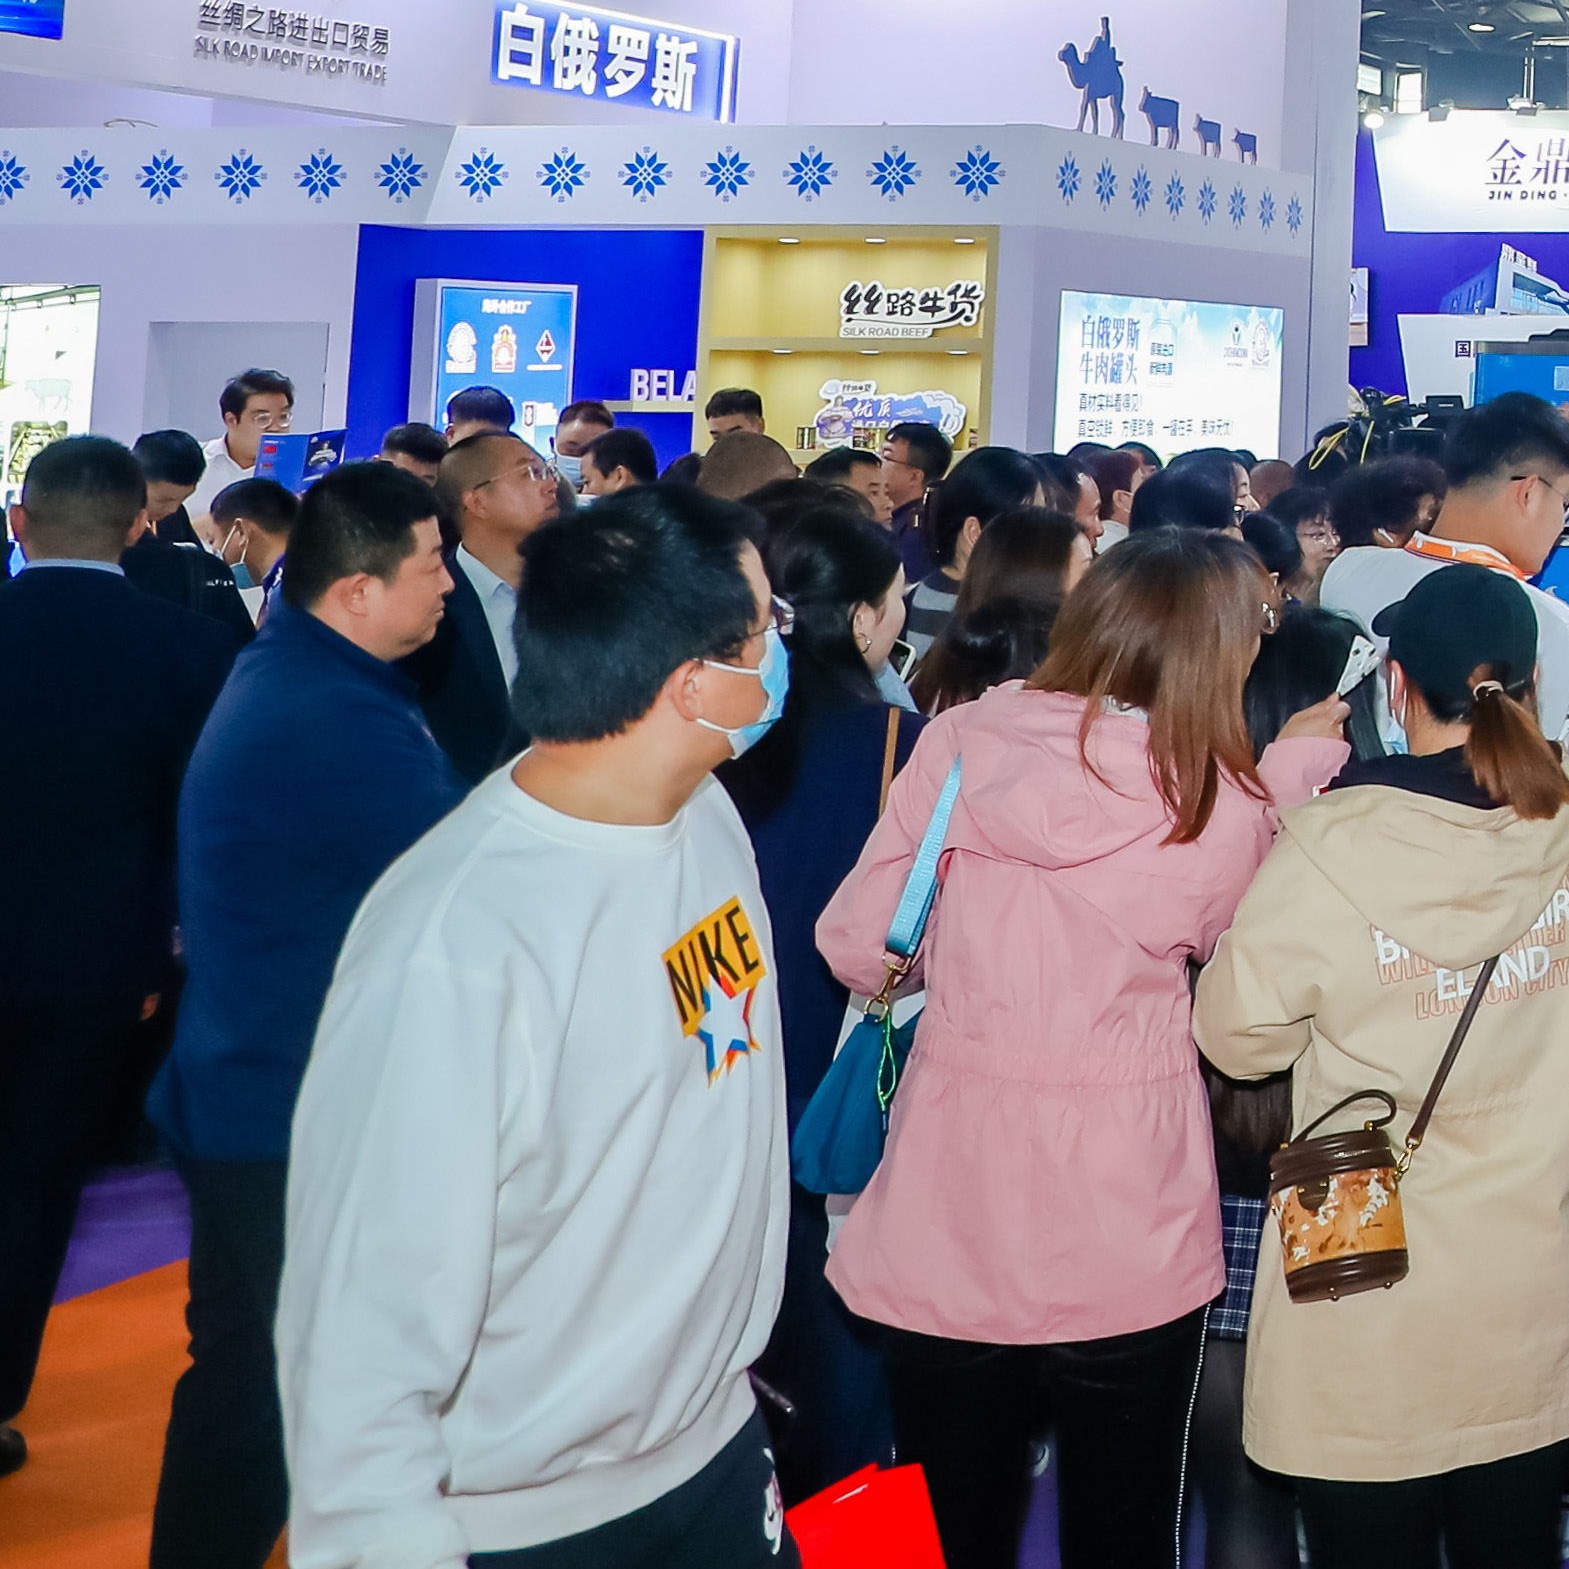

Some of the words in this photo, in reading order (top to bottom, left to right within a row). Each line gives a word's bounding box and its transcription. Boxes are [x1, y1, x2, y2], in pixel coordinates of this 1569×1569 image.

[194, 36, 219, 56] SILK
[224, 41, 258, 62] ROAD
[261, 47, 304, 69] IMPORT
[307, 54, 351, 77] EXPORT
[352, 62, 388, 84] TRADE
[497, 2, 698, 113] 白俄罗斯
[1488, 189, 1512, 201] JIN
[1520, 189, 1557, 201] DING
[843, 283, 981, 323] 丝路牛货
[842, 327, 866, 337] SILK
[868, 327, 899, 337] ROAD
[901, 327, 929, 337] BEEF
[1081, 314, 1141, 351] 白俄罗斯
[1080, 351, 1137, 385] 牛肉罐头
[666, 906, 759, 1025] NIKE
[1415, 979, 1519, 1020] LONON
